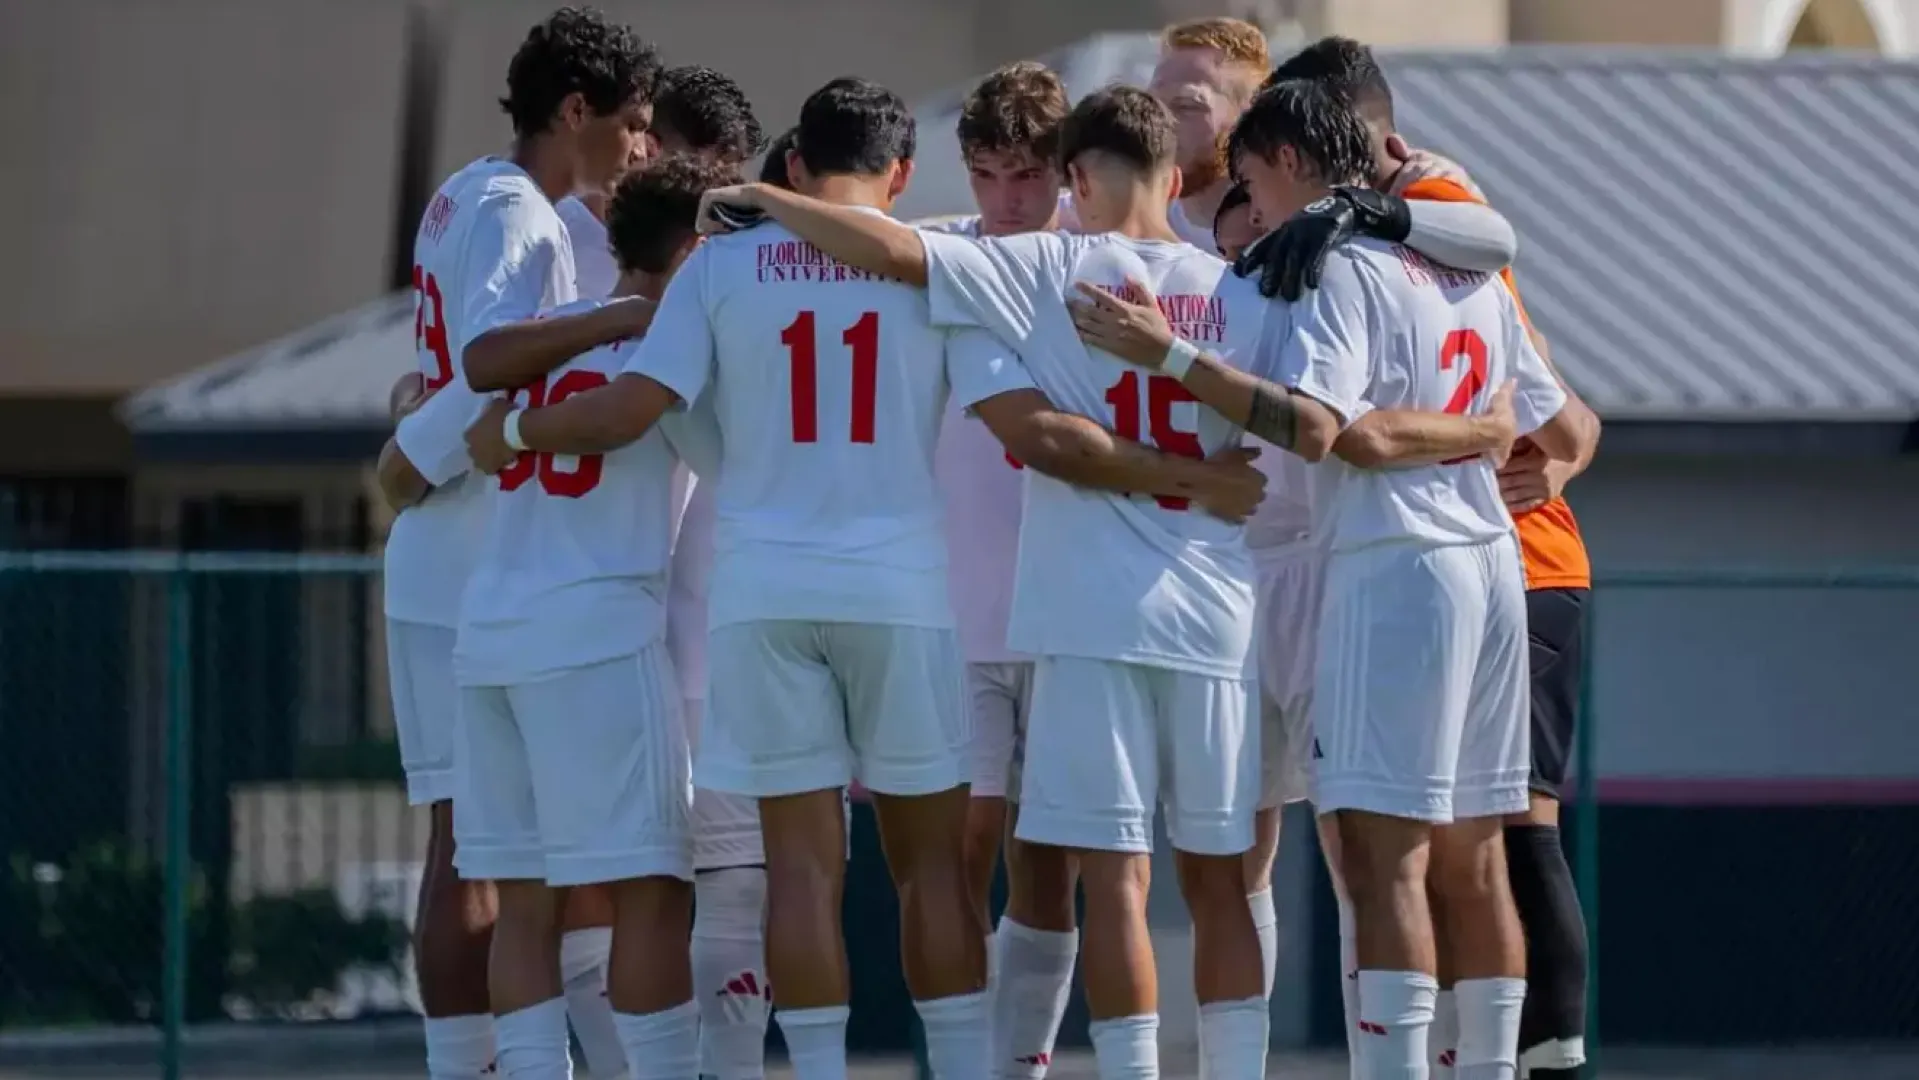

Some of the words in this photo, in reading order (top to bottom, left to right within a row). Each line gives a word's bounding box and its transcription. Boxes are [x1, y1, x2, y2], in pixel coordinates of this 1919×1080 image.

[780, 310, 879, 444] 11
[1105, 370, 1206, 511] 15
[1440, 329, 1488, 465] 2
